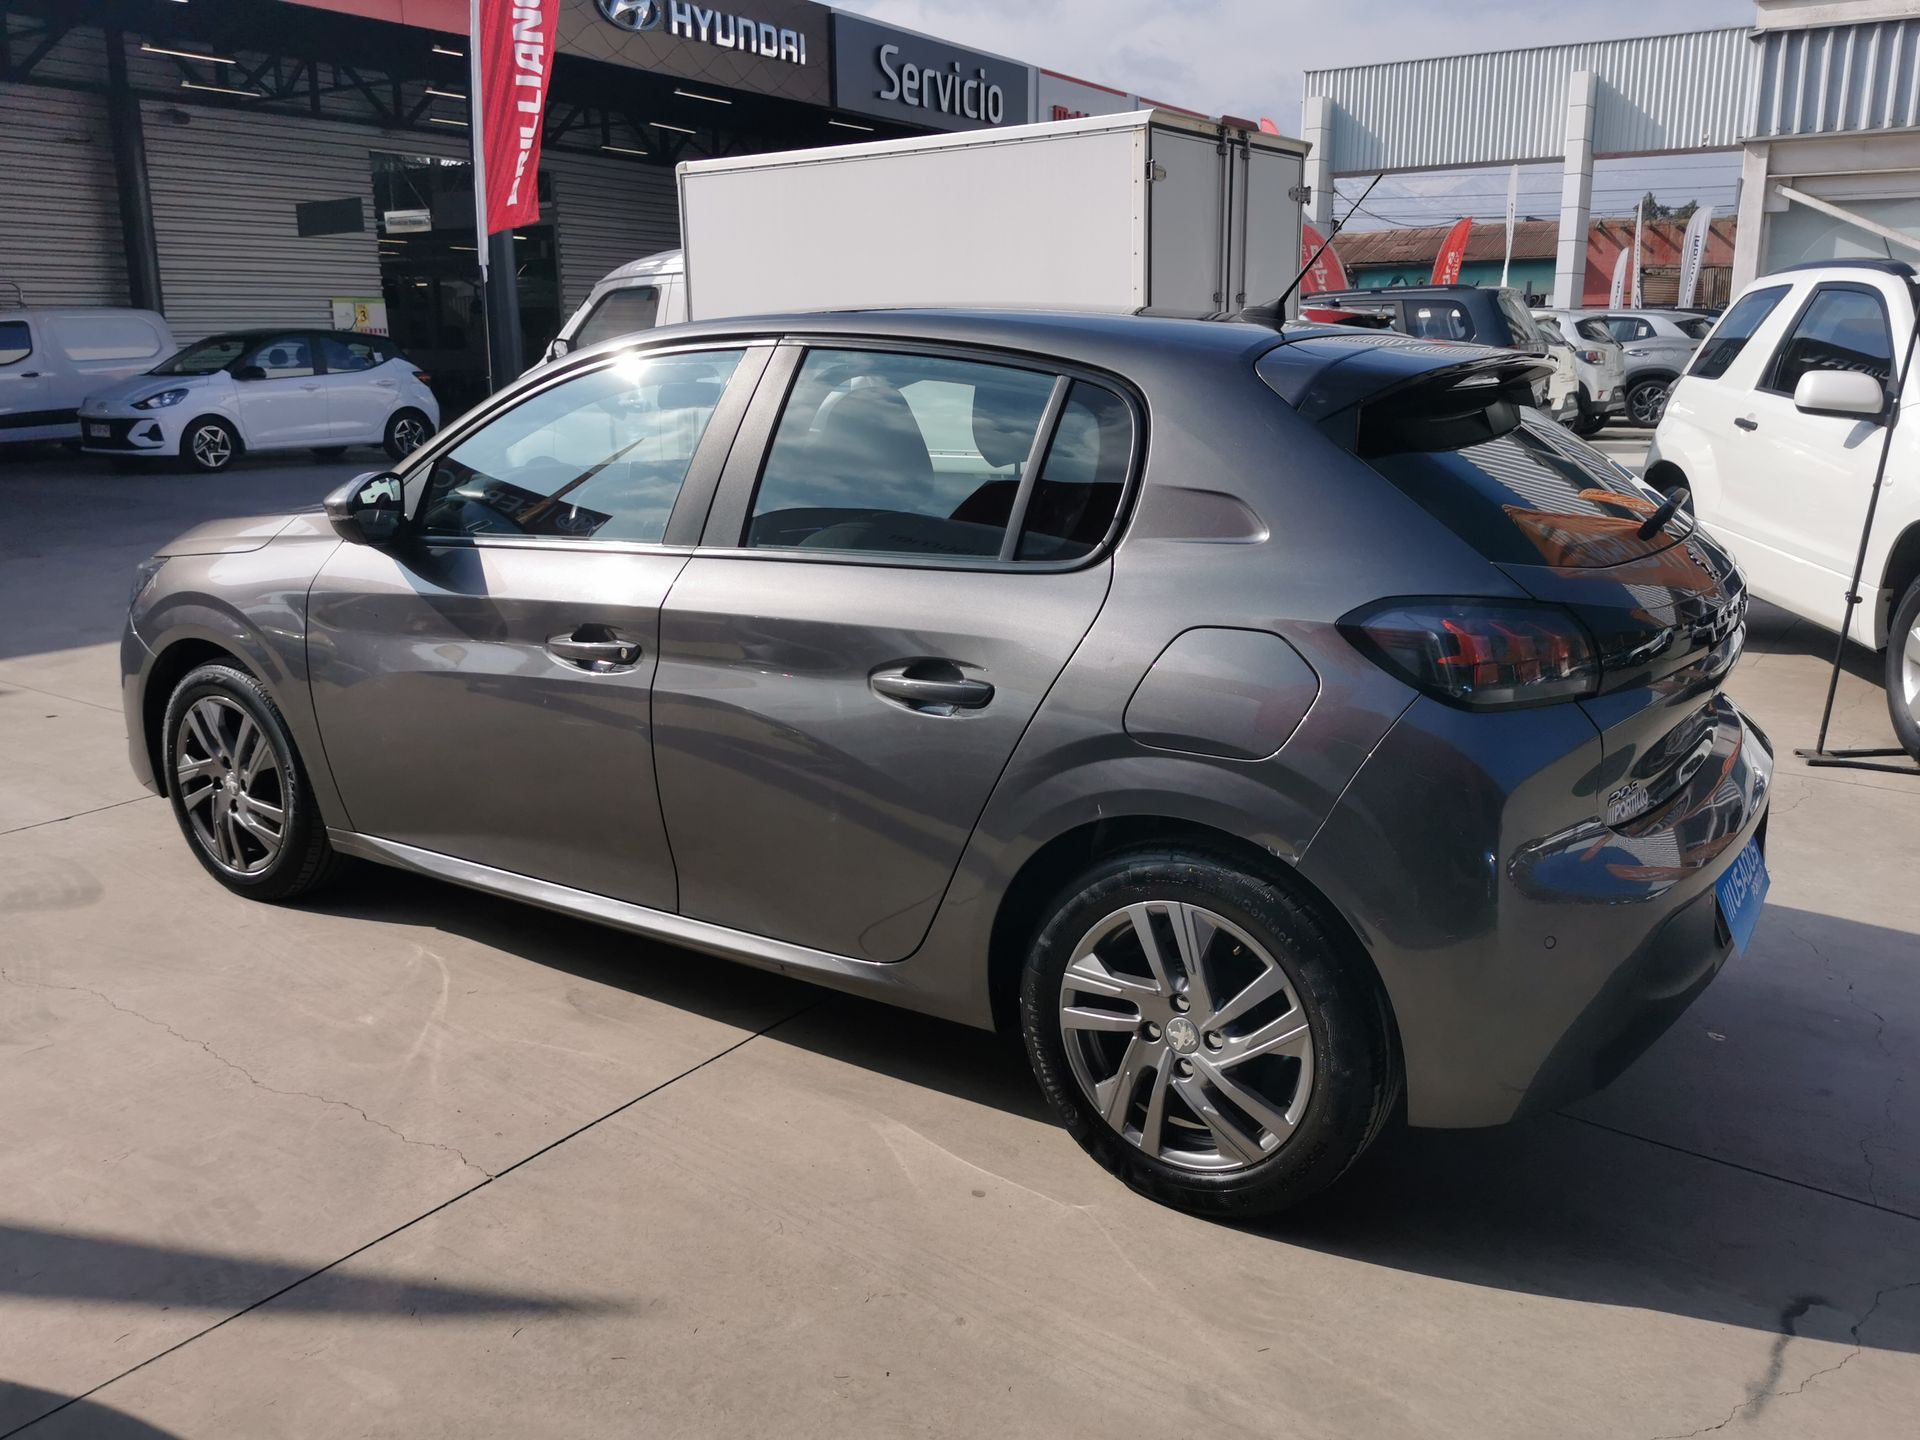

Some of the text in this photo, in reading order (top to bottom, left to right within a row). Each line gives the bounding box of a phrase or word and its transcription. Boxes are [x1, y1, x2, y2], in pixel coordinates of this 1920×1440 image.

[670, 0, 806, 65] HYUNDAI
[507, 0, 543, 206] RILLIAN
[879, 43, 1004, 124] Servicio
[1614, 788, 1649, 823] PORTILLO
